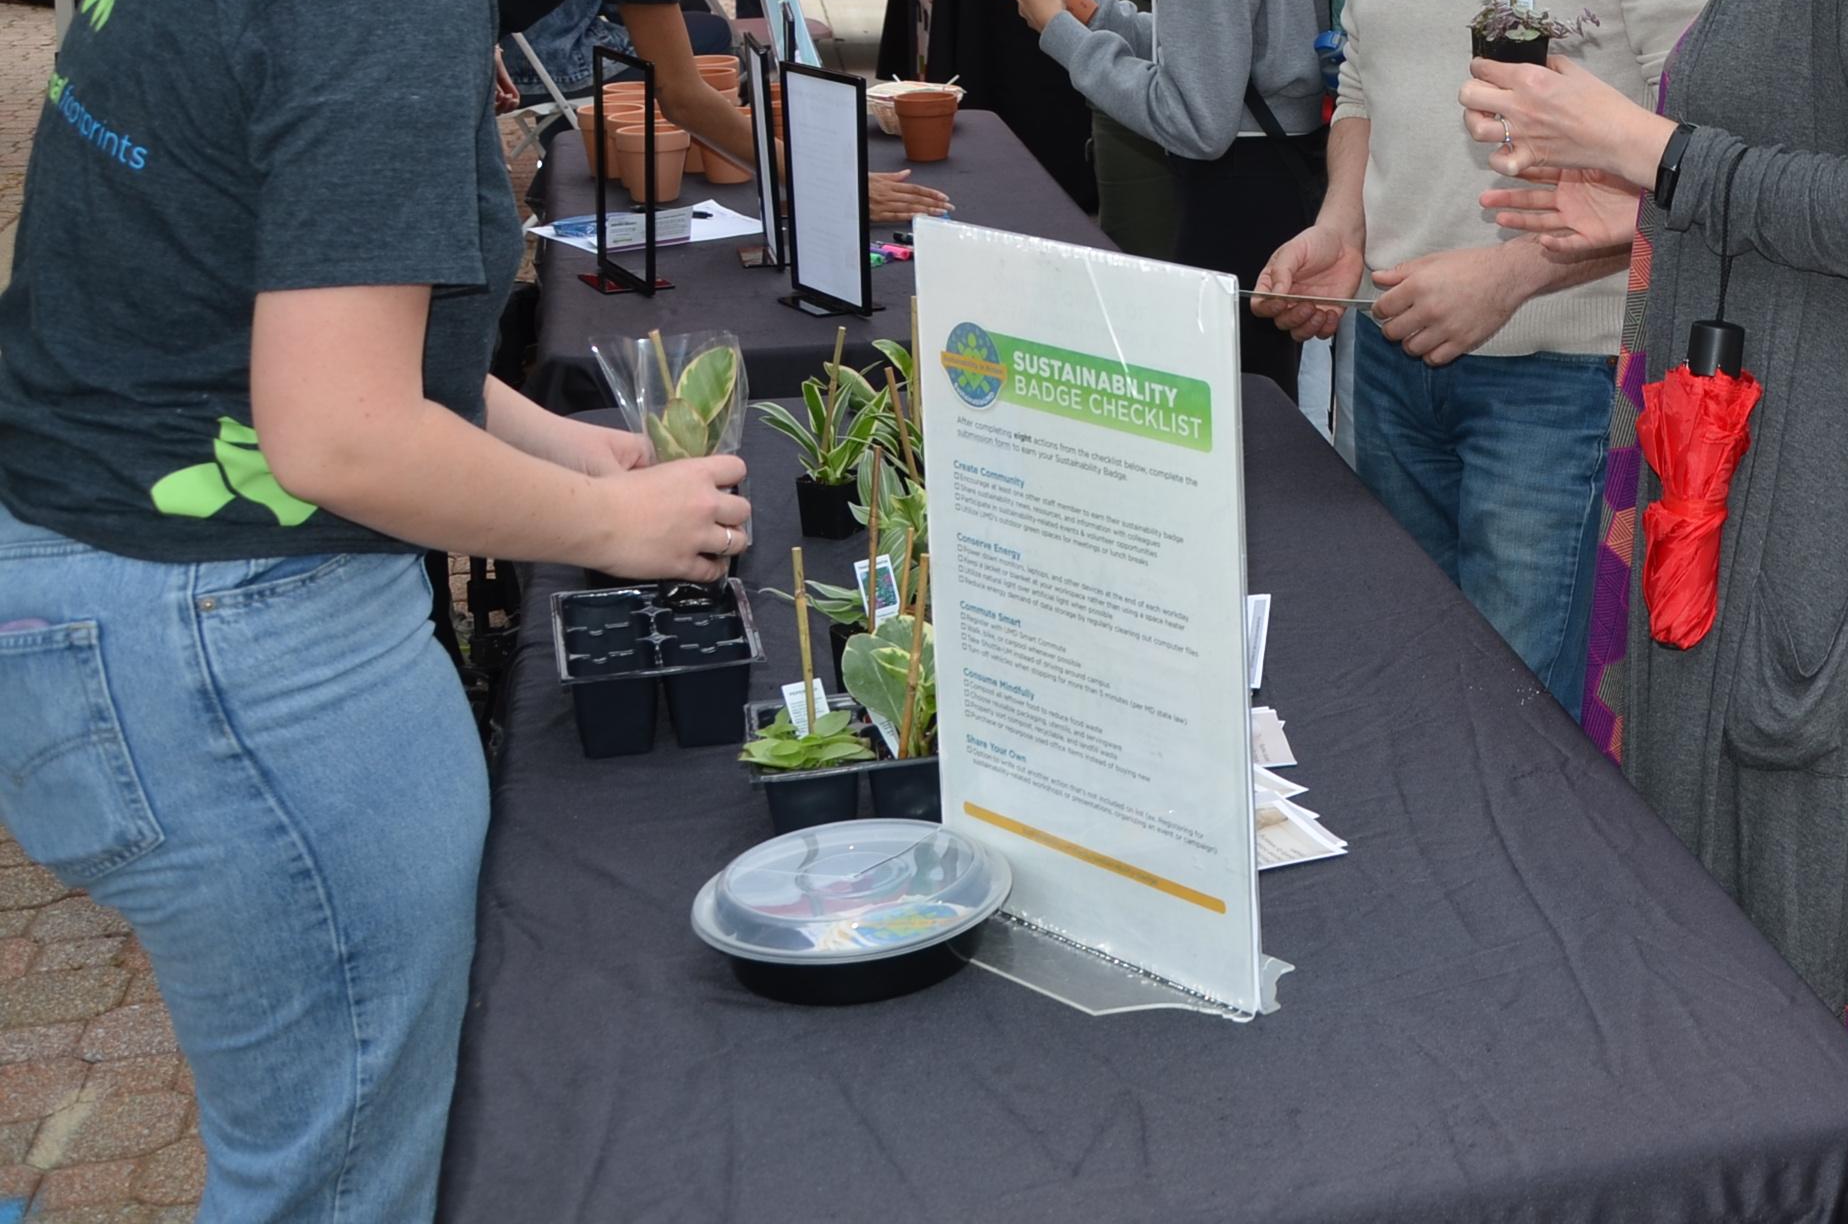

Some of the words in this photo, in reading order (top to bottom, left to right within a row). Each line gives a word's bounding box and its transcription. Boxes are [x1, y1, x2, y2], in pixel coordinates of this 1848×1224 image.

[1013, 349, 1177, 409] SUSTAINABILITY
[1014, 375, 1083, 411] BADGE
[1089, 395, 1203, 440] CHECKLIST
[953, 459, 978, 475] Create
[980, 467, 1025, 489] Community
[957, 532, 992, 551] Conserve
[994, 544, 1021, 562] Energy
[960, 600, 996, 619] Commute
[998, 612, 1021, 627] Smart
[963, 667, 997, 687] Consume
[1000, 680, 1035, 702] Mindfully
[966, 733, 987, 748] Share
[990, 742, 1007, 755] Your
[1008, 749, 1027, 762] Own
